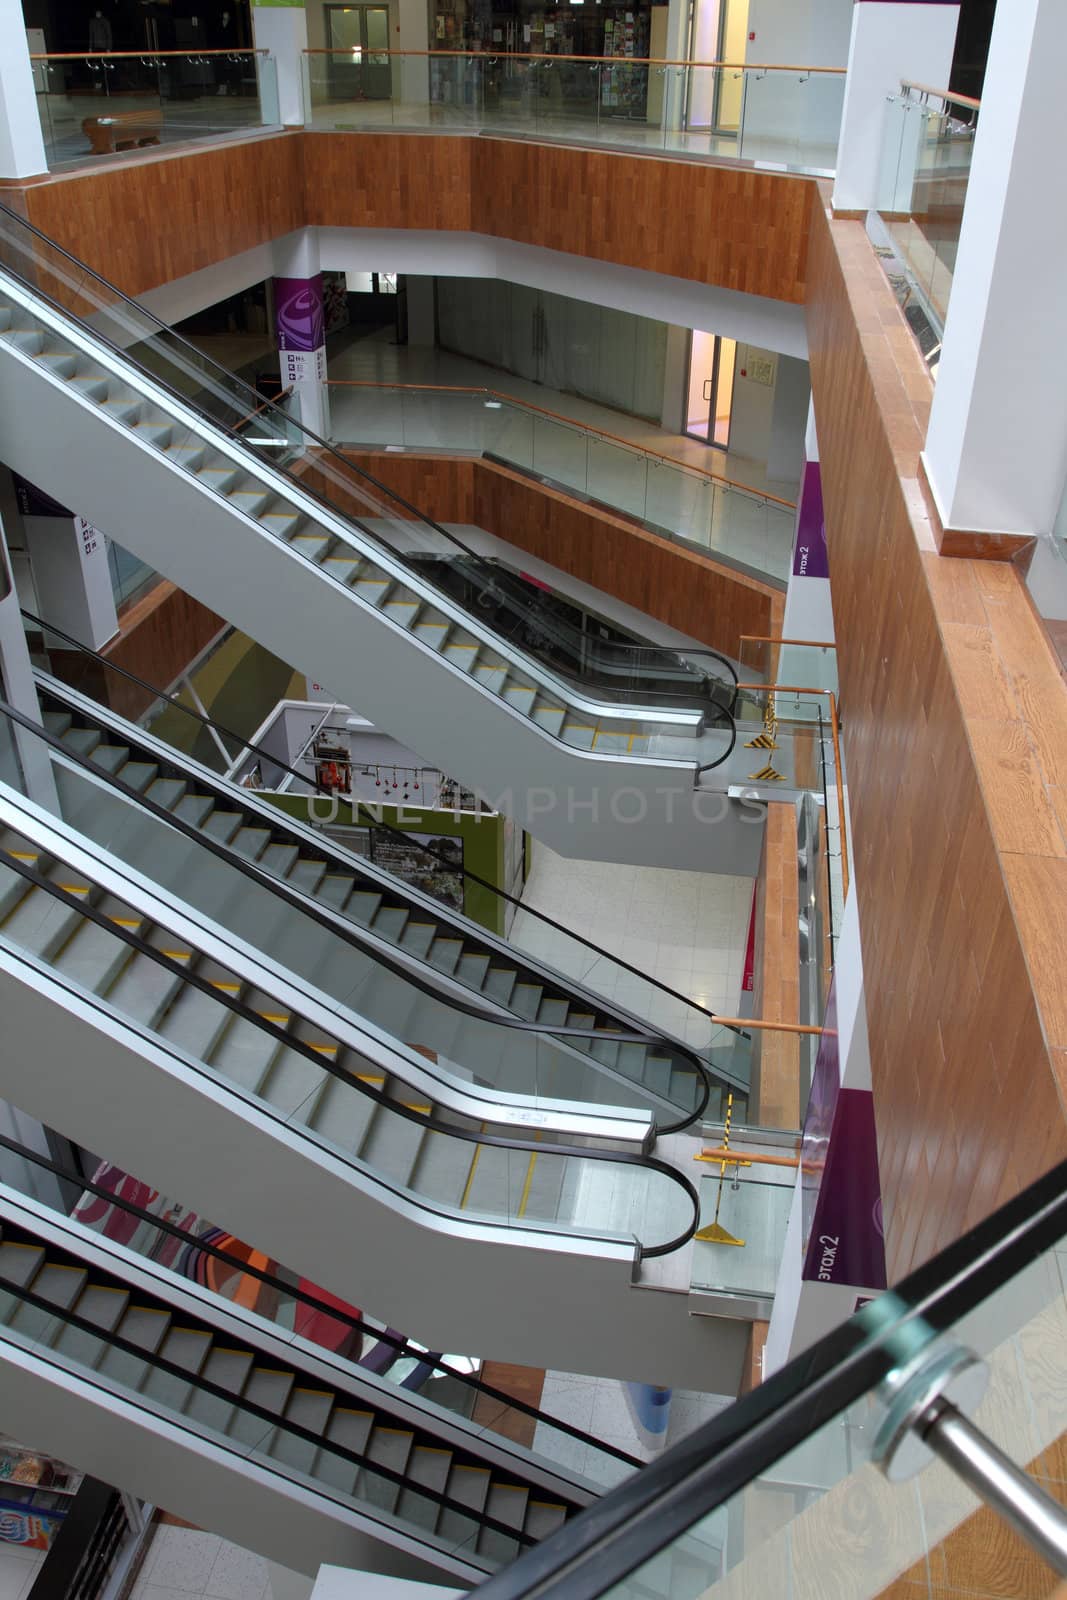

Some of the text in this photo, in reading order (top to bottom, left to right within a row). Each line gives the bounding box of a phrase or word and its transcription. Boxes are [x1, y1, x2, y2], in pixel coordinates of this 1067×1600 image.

[799, 553, 809, 575] этаж
[817, 1234, 840, 1281] этаж 2
